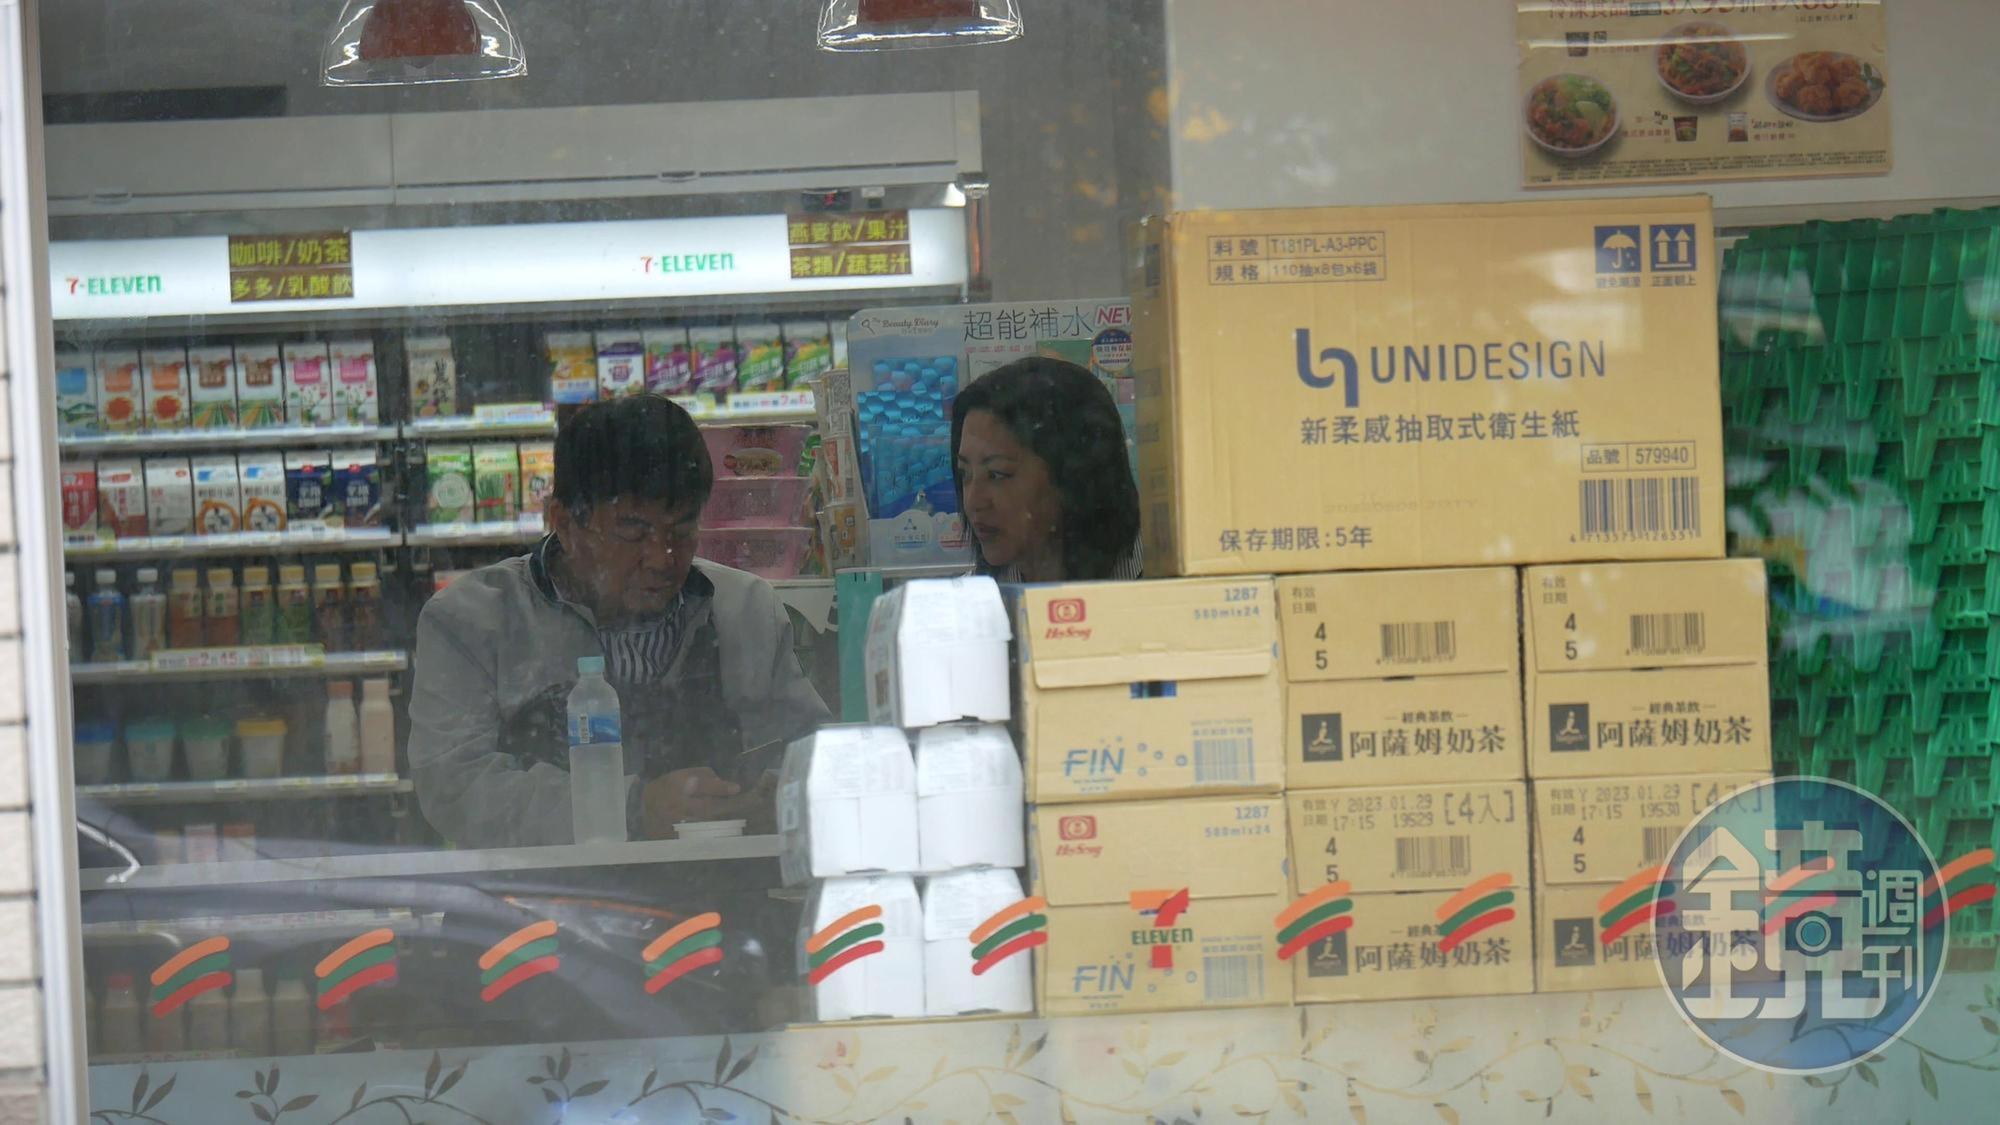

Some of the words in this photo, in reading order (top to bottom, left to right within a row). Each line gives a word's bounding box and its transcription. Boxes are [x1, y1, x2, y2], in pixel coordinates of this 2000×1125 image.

[231, 238, 349, 266] 咖啡/奶茶
[1271, 236, 1377, 254] T181PL-A3-PPC
[1215, 264, 1258, 281] 規格
[232, 274, 352, 299] 多多/乳酸飲
[963, 306, 1093, 342] 超能補水
[1370, 340, 1606, 384] UNIDESIGN
[1300, 409, 1581, 446] 新柔感抽取式衛生紙
[1586, 449, 1620, 464] 品號
[1635, 446, 1688, 464] 579940
[1219, 525, 1373, 552] 保存期限:5年
[1224, 587, 1258, 602] 1287
[1315, 622, 1327, 641] 4
[1565, 613, 1576, 632] 4
[1316, 650, 1328, 670] 5
[1565, 641, 1577, 660] 5
[1350, 725, 1506, 758] 阿薩姆奶茶
[1597, 716, 1752, 749] 阿薩姆奶茶
[1061, 747, 1125, 777] FIN
[1235, 806, 1270, 820] 1287
[1572, 826, 1585, 845] 4
[1325, 837, 1337, 856] 4
[1573, 854, 1586, 873] 5
[1326, 864, 1338, 884] 5
[1355, 937, 1511, 973] 阿薩姆奶茶
[1073, 962, 1135, 993] FIN
